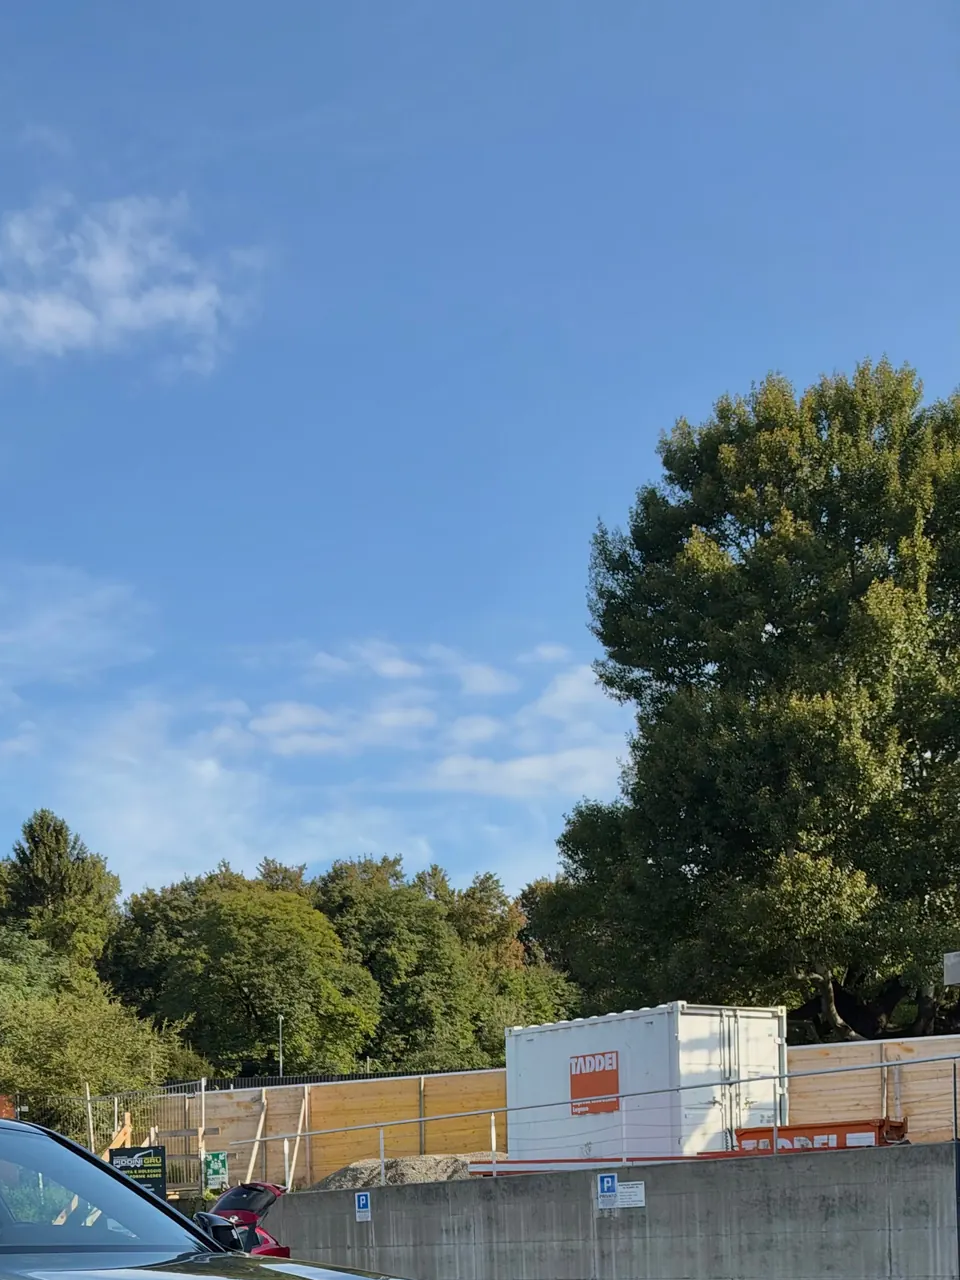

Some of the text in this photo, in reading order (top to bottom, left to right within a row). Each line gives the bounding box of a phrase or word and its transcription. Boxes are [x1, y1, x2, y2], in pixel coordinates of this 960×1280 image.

[569, 1053, 617, 1075] TADDEI
[603, 1177, 612, 1192] P
[360, 1195, 366, 1208] P
